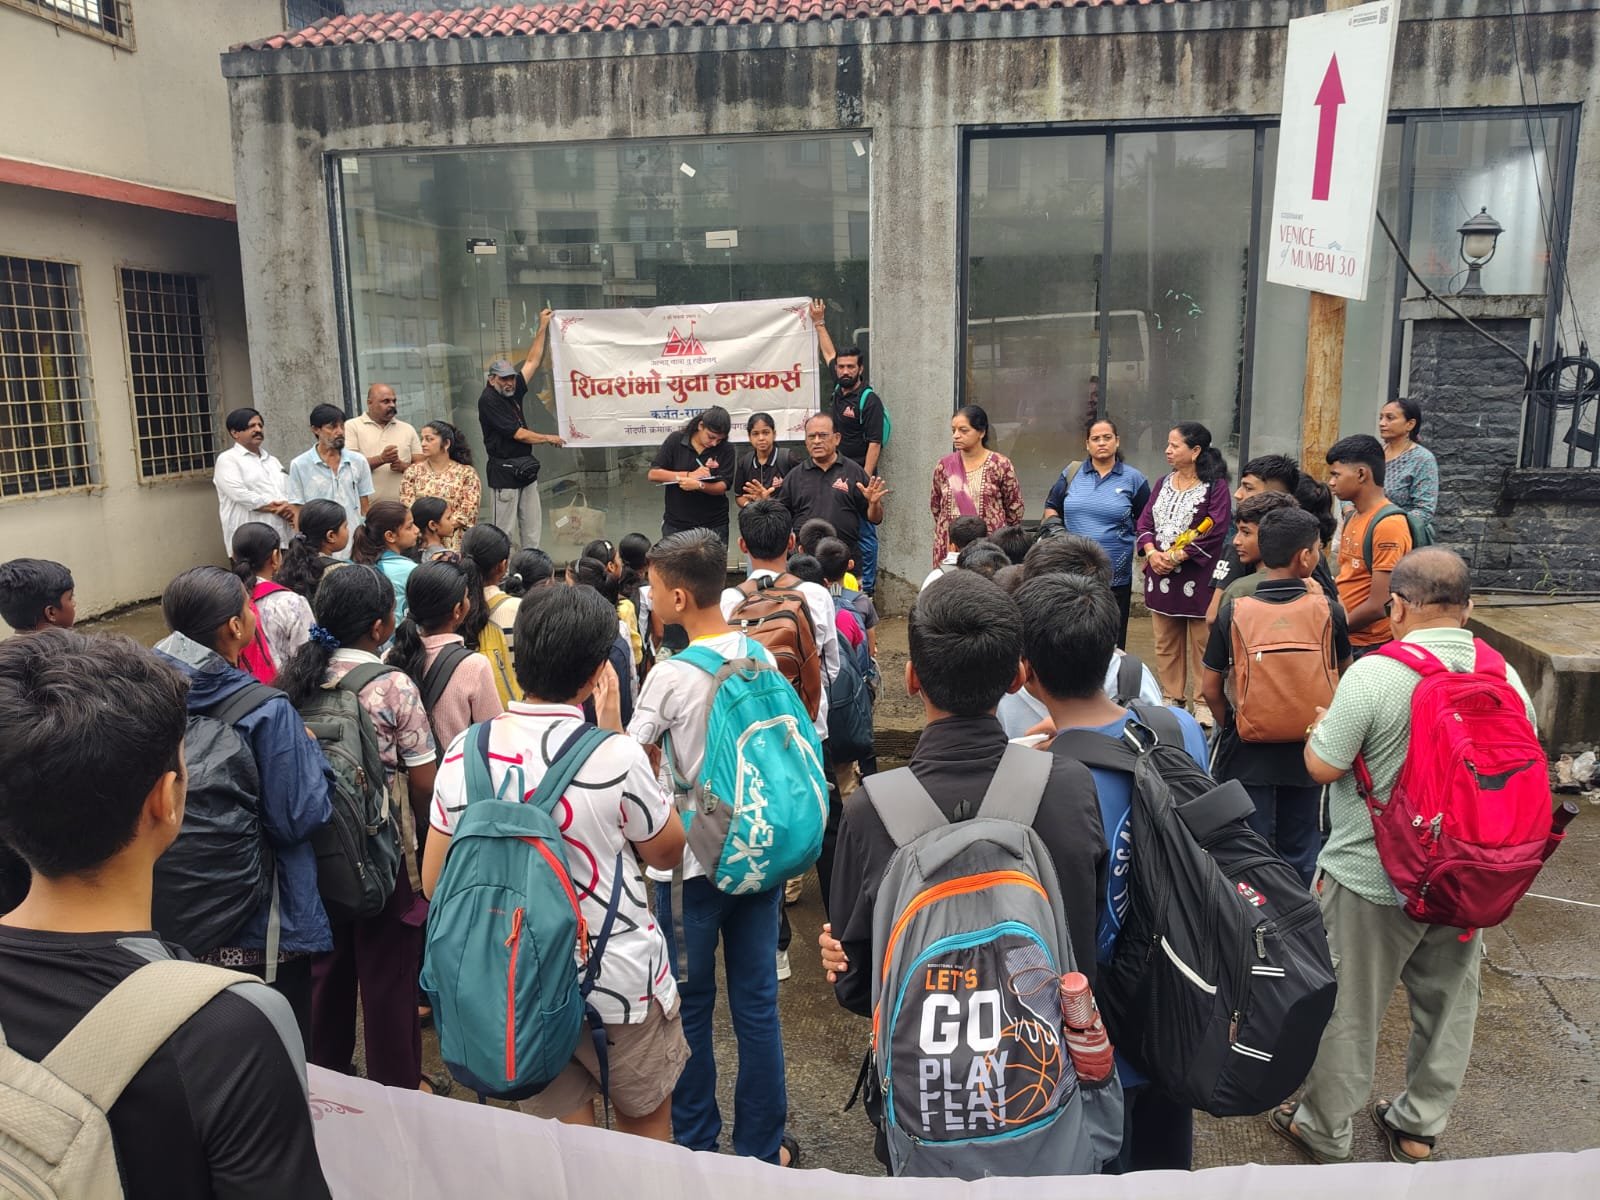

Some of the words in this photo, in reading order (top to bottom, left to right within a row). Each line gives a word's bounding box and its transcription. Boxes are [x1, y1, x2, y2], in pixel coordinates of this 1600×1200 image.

[1280, 223, 1317, 248] VENICE
[1291, 248, 1336, 273] MUMBAI
[1338, 255, 1356, 277] 3.0
[570, 368, 661, 400] शिवशंभो
[666, 372, 709, 404] युवा
[715, 363, 802, 396] हायकर्स
[925, 968, 978, 991] LET'S
[919, 989, 1002, 1055] GO
[919, 1050, 1009, 1090] PLAY
